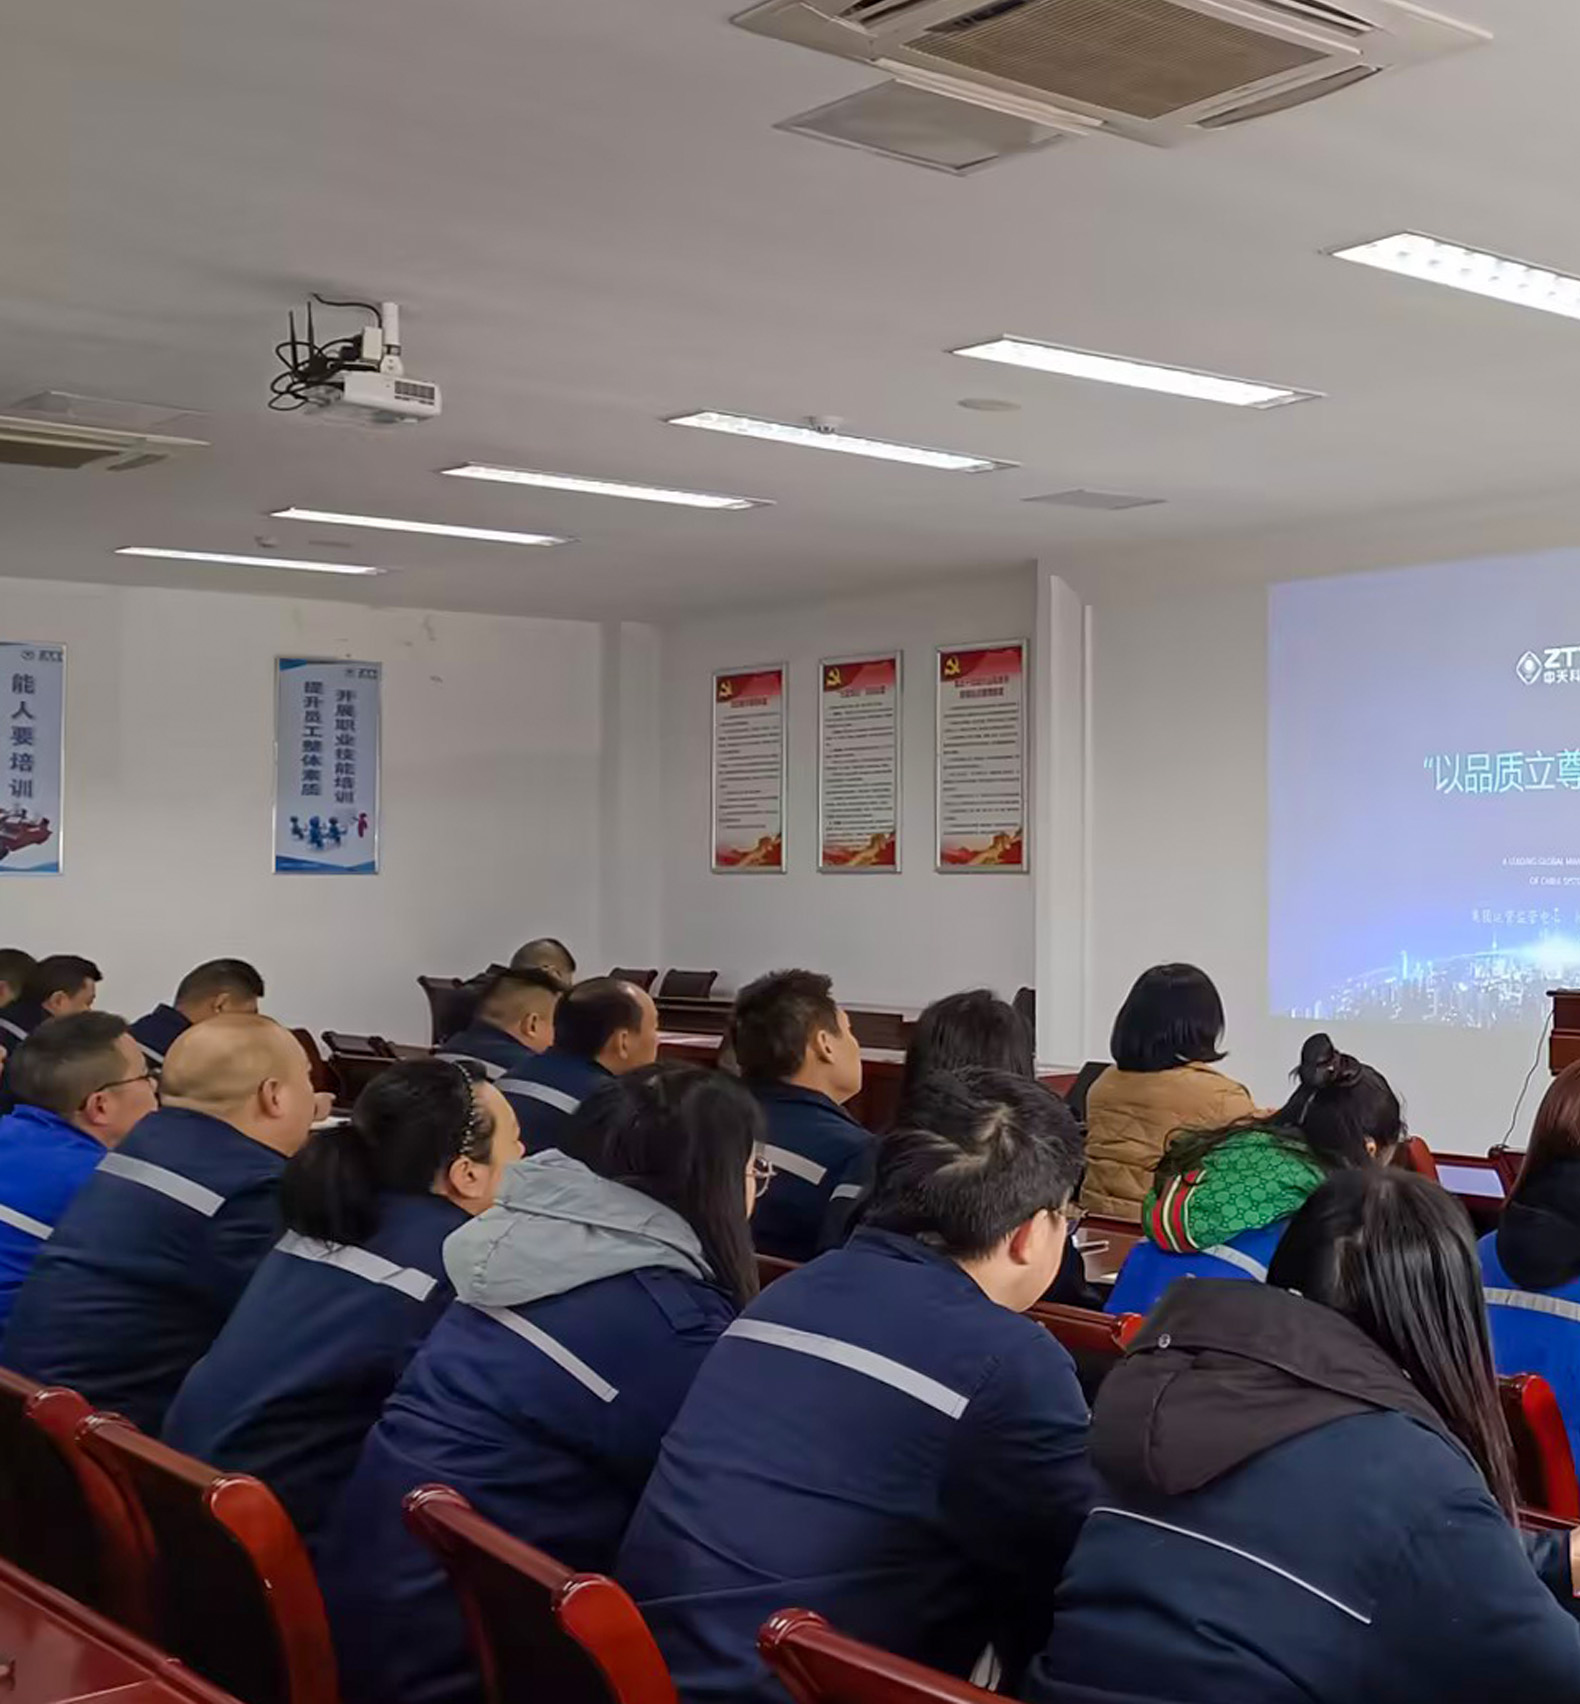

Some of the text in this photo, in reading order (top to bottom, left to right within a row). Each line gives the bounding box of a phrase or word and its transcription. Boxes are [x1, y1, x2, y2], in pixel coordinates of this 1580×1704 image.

[9, 672, 35, 799] 能人要培训
